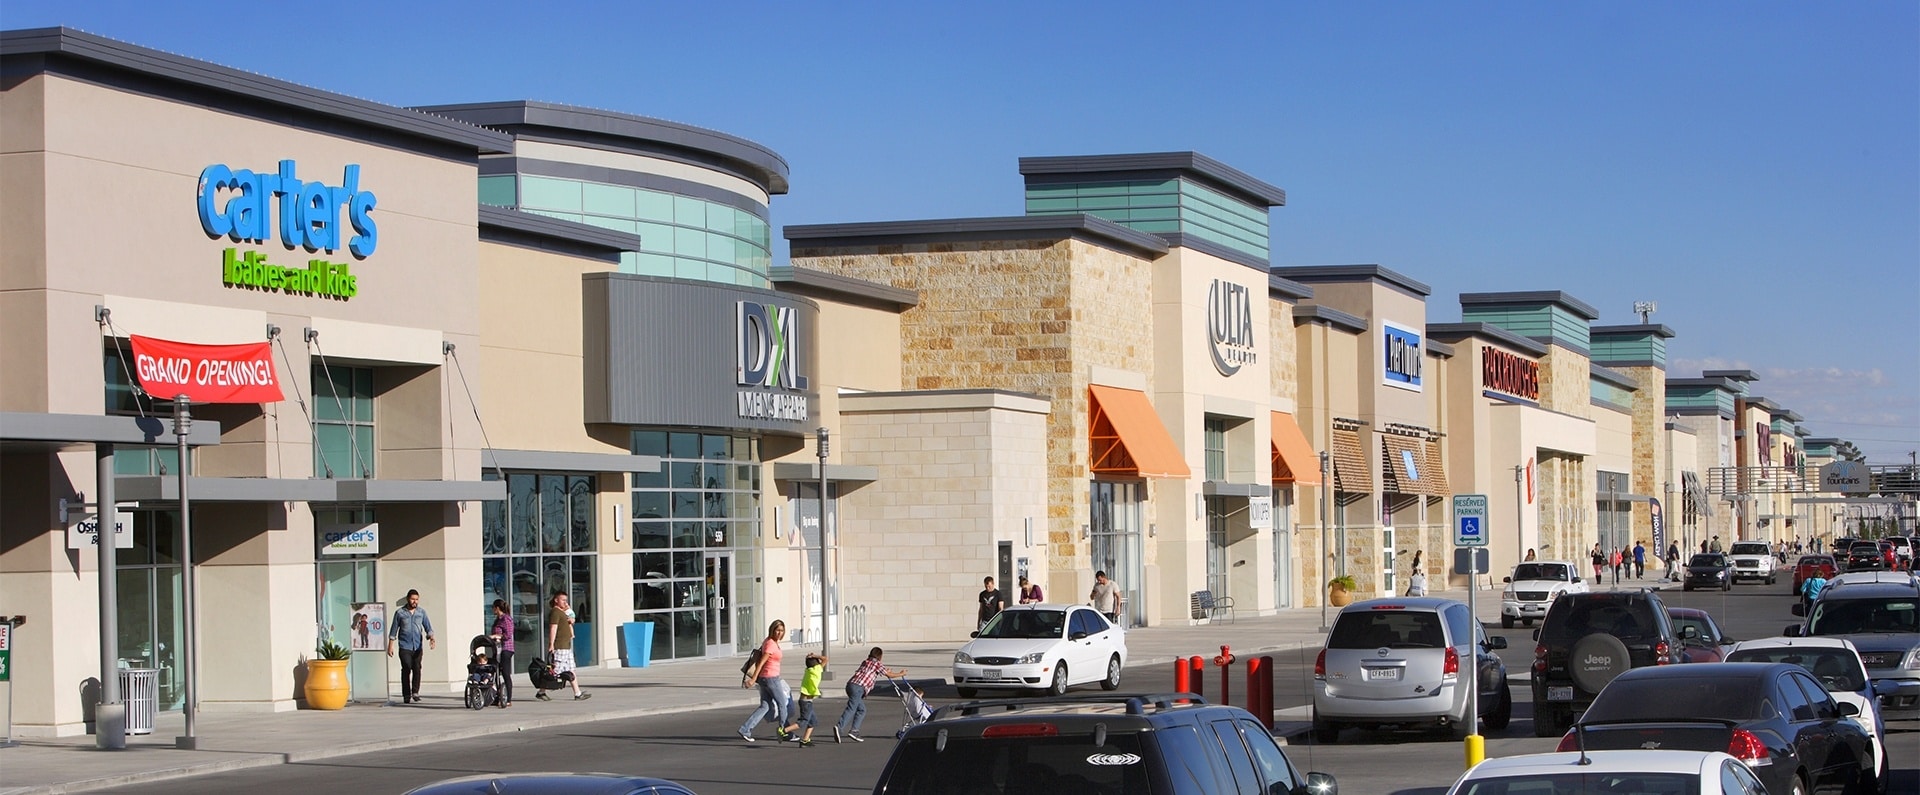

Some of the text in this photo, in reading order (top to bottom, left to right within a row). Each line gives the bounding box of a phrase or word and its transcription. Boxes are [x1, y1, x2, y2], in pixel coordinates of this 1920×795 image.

[197, 159, 377, 257] carter's
[223, 248, 357, 299] babies and kids
[1213, 278, 1254, 347] ULTA
[737, 300, 808, 389] DXL
[137, 353, 273, 386] GRAND OPENING!
[1503, 352, 1521, 395] ROOM
[1827, 477, 1860, 485] fountains
[1831, 472, 1841, 480] the
[1455, 499, 1485, 507] RESERVED
[1457, 508, 1483, 516] PARKING
[325, 530, 375, 541] carter's
[1584, 654, 1612, 665] Jeep
